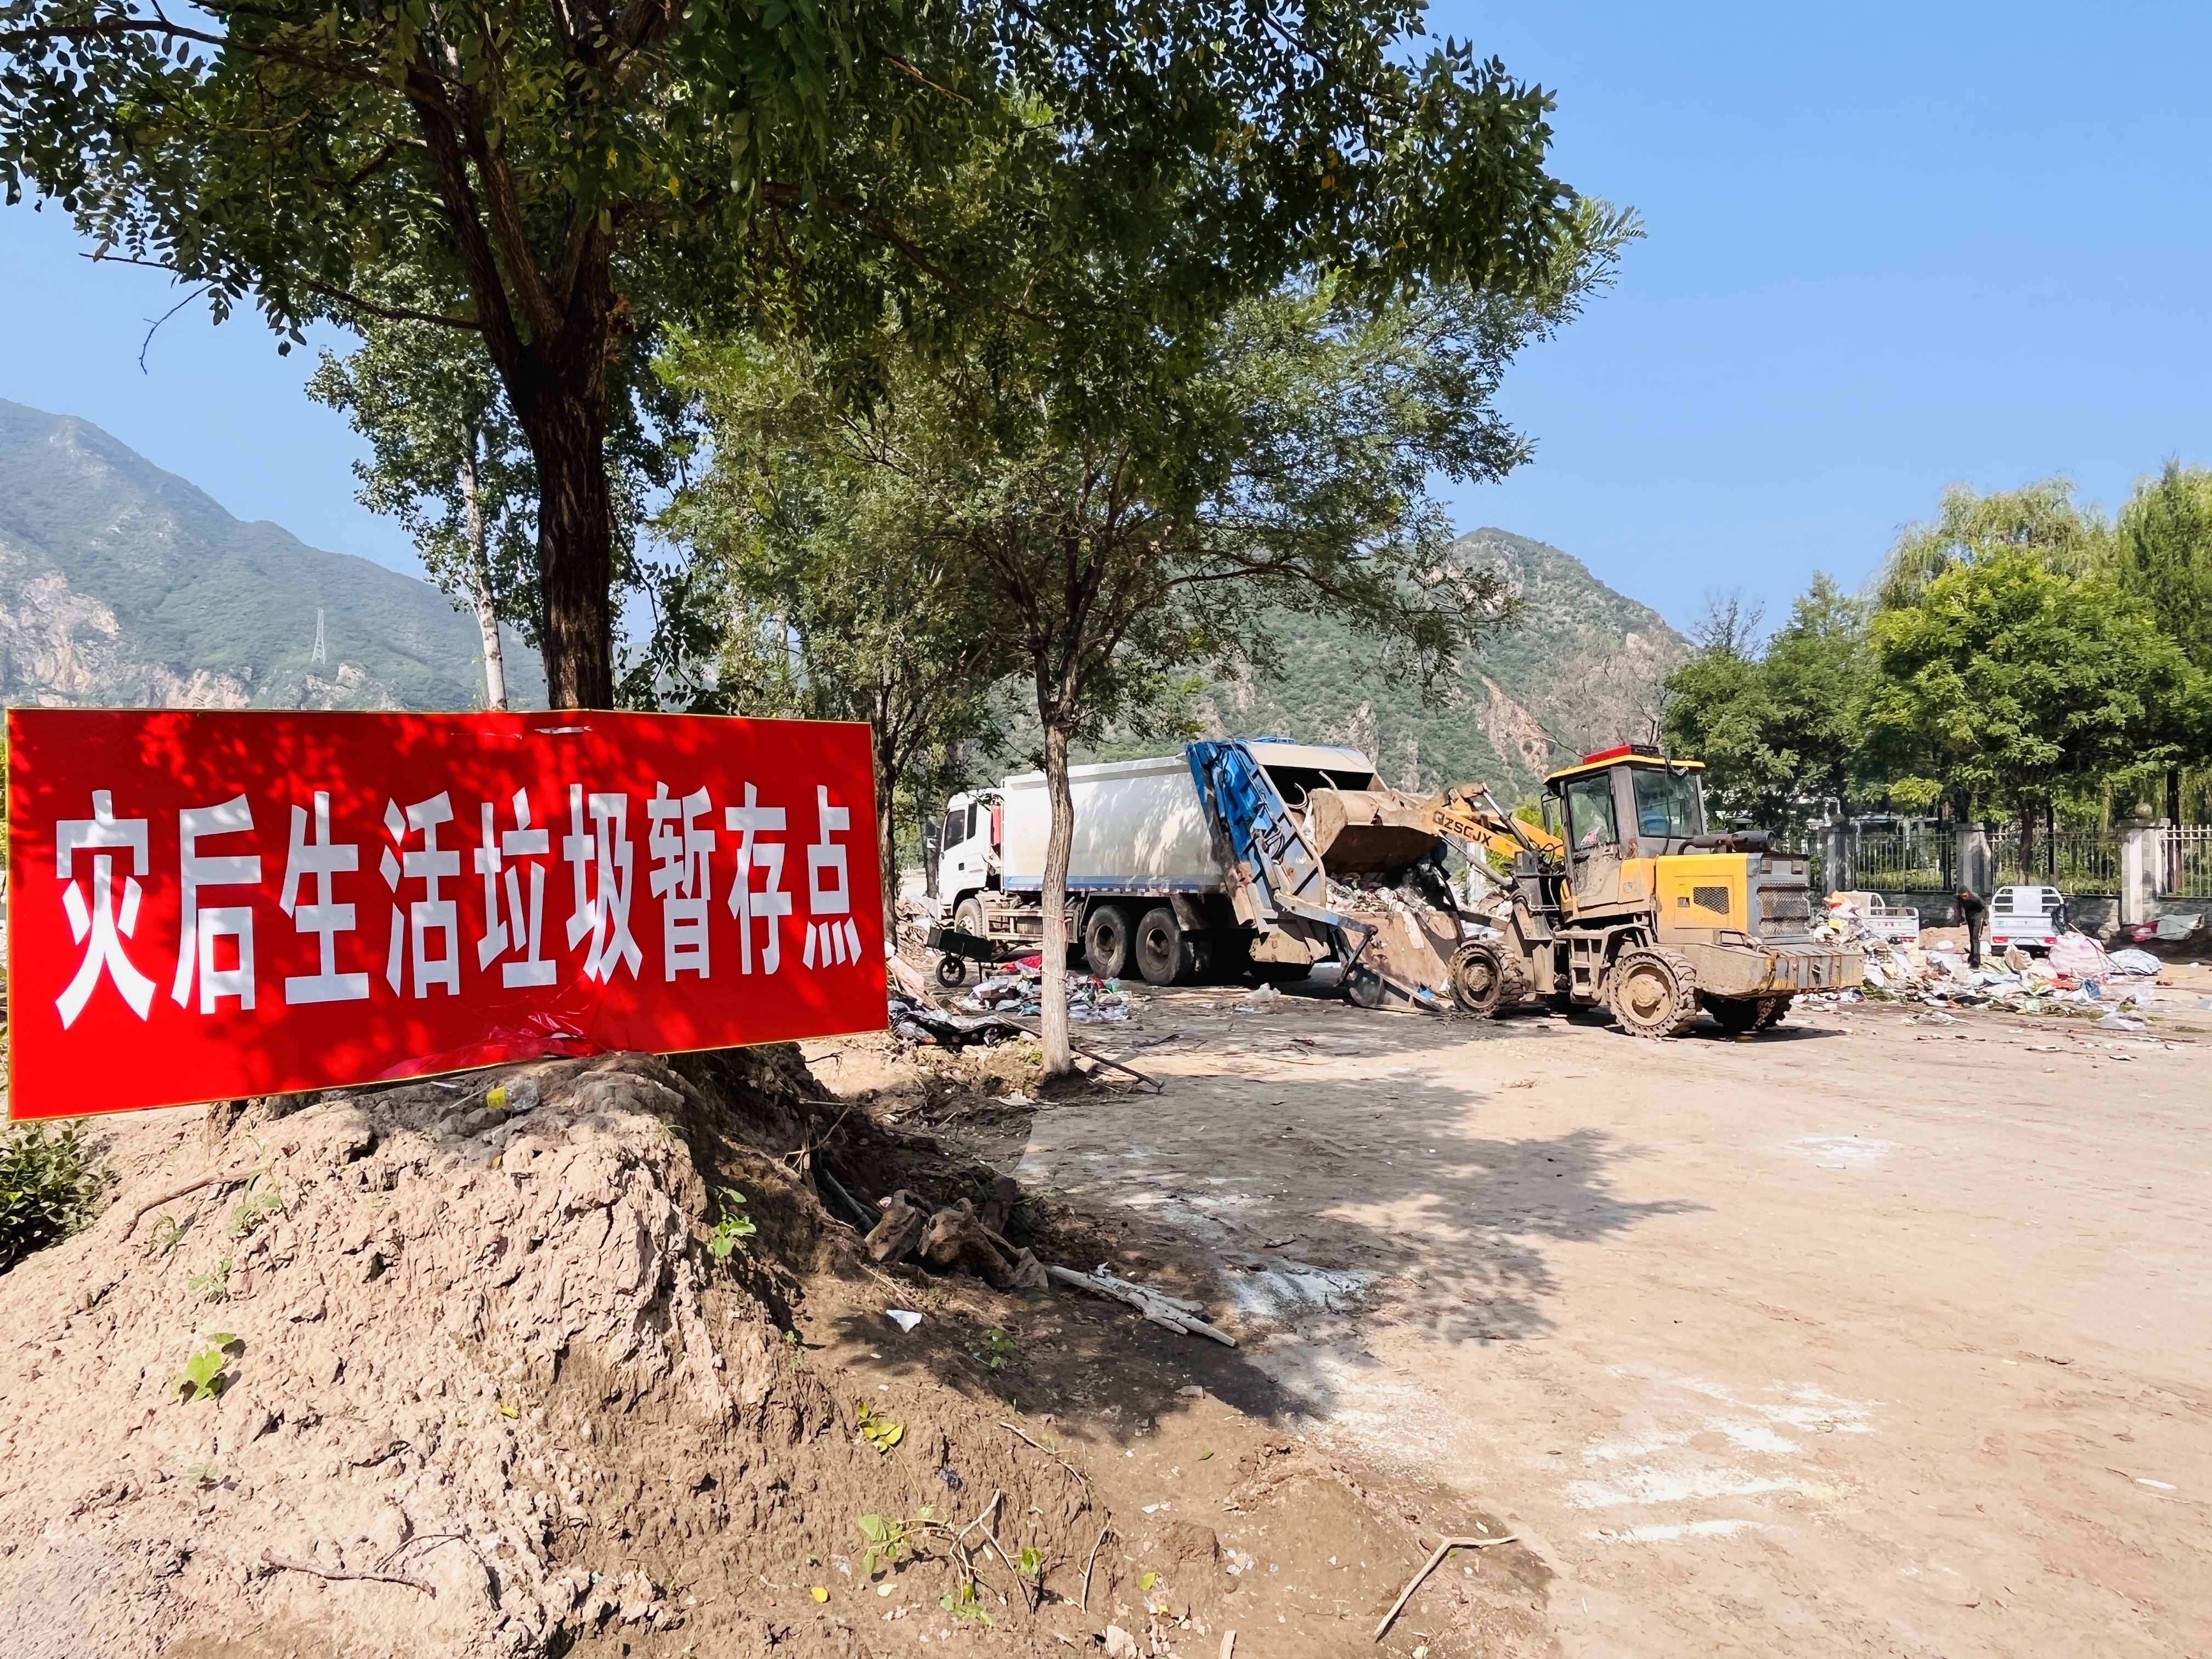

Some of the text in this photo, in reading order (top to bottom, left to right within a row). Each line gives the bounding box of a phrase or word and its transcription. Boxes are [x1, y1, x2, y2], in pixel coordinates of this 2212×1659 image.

[55, 781, 862, 1030] 灾后生活垃圾暂存点
